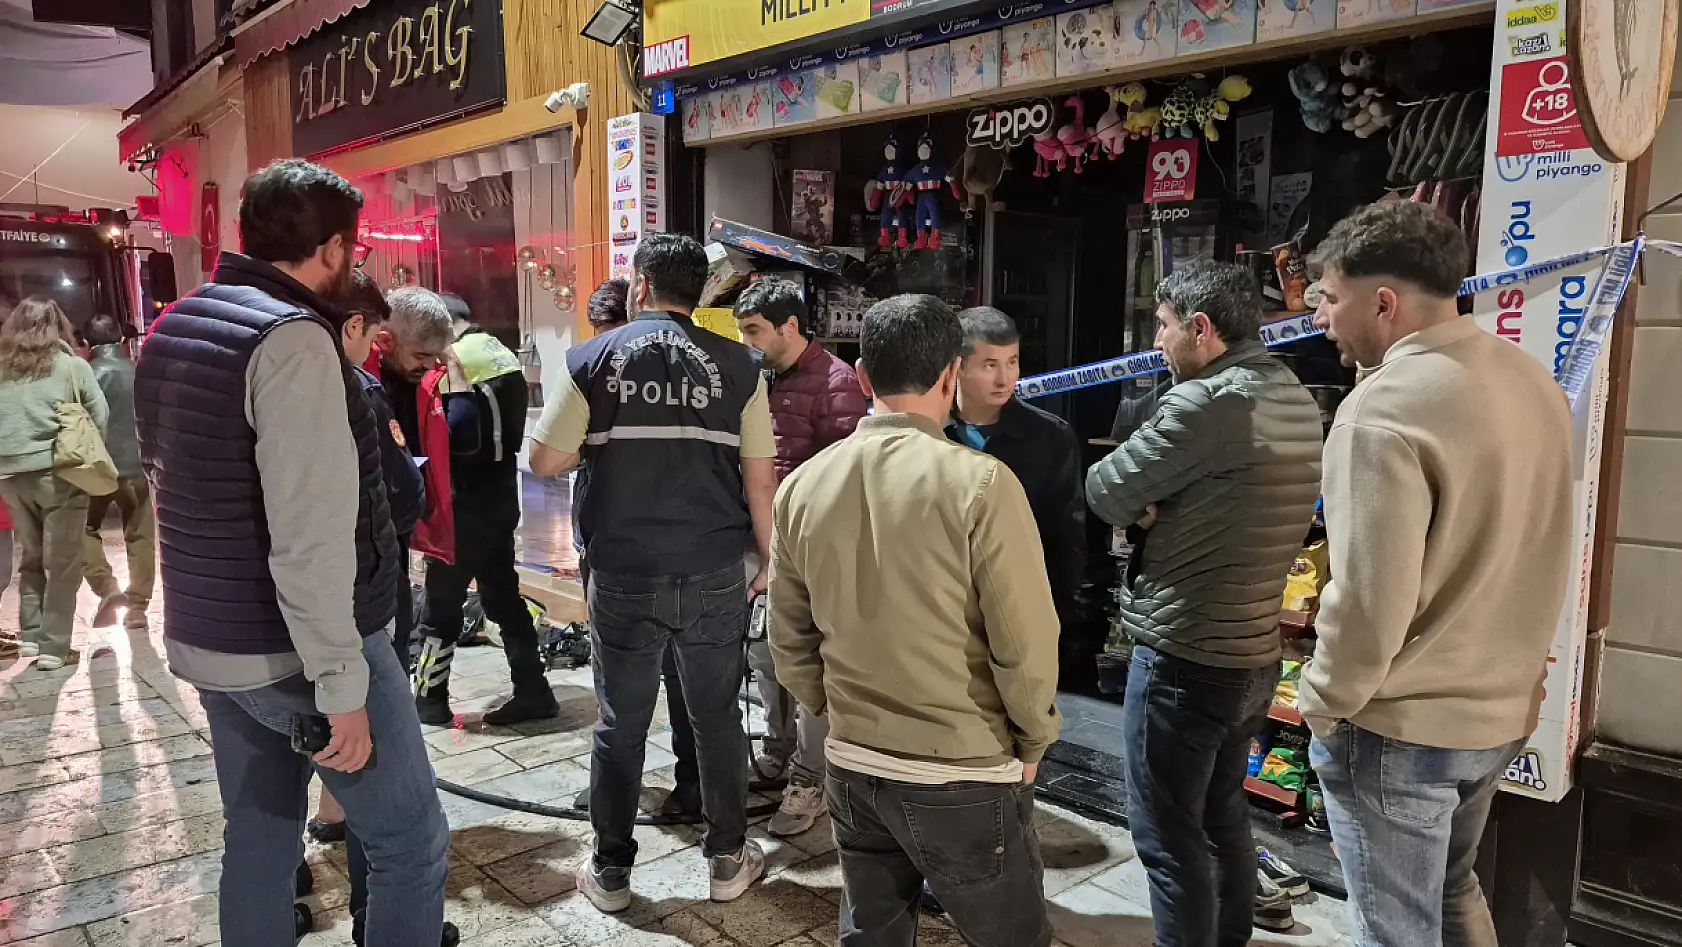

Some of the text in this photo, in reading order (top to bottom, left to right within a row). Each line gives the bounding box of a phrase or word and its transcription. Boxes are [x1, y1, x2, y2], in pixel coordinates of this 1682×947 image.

[1507, 15, 1538, 28] iddaa
[644, 36, 689, 77] MARVEL
[657, 95, 667, 107] 11
[1532, 93, 1568, 111] +18
[971, 104, 1048, 142] zippo
[1152, 148, 1190, 181] 90
[1536, 150, 1571, 165] milli
[1536, 163, 1602, 180] piyango
[1152, 179, 1186, 192] ZIPPO
[1127, 352, 1167, 373] GİRİLME
[620, 377, 710, 409] POLİS
